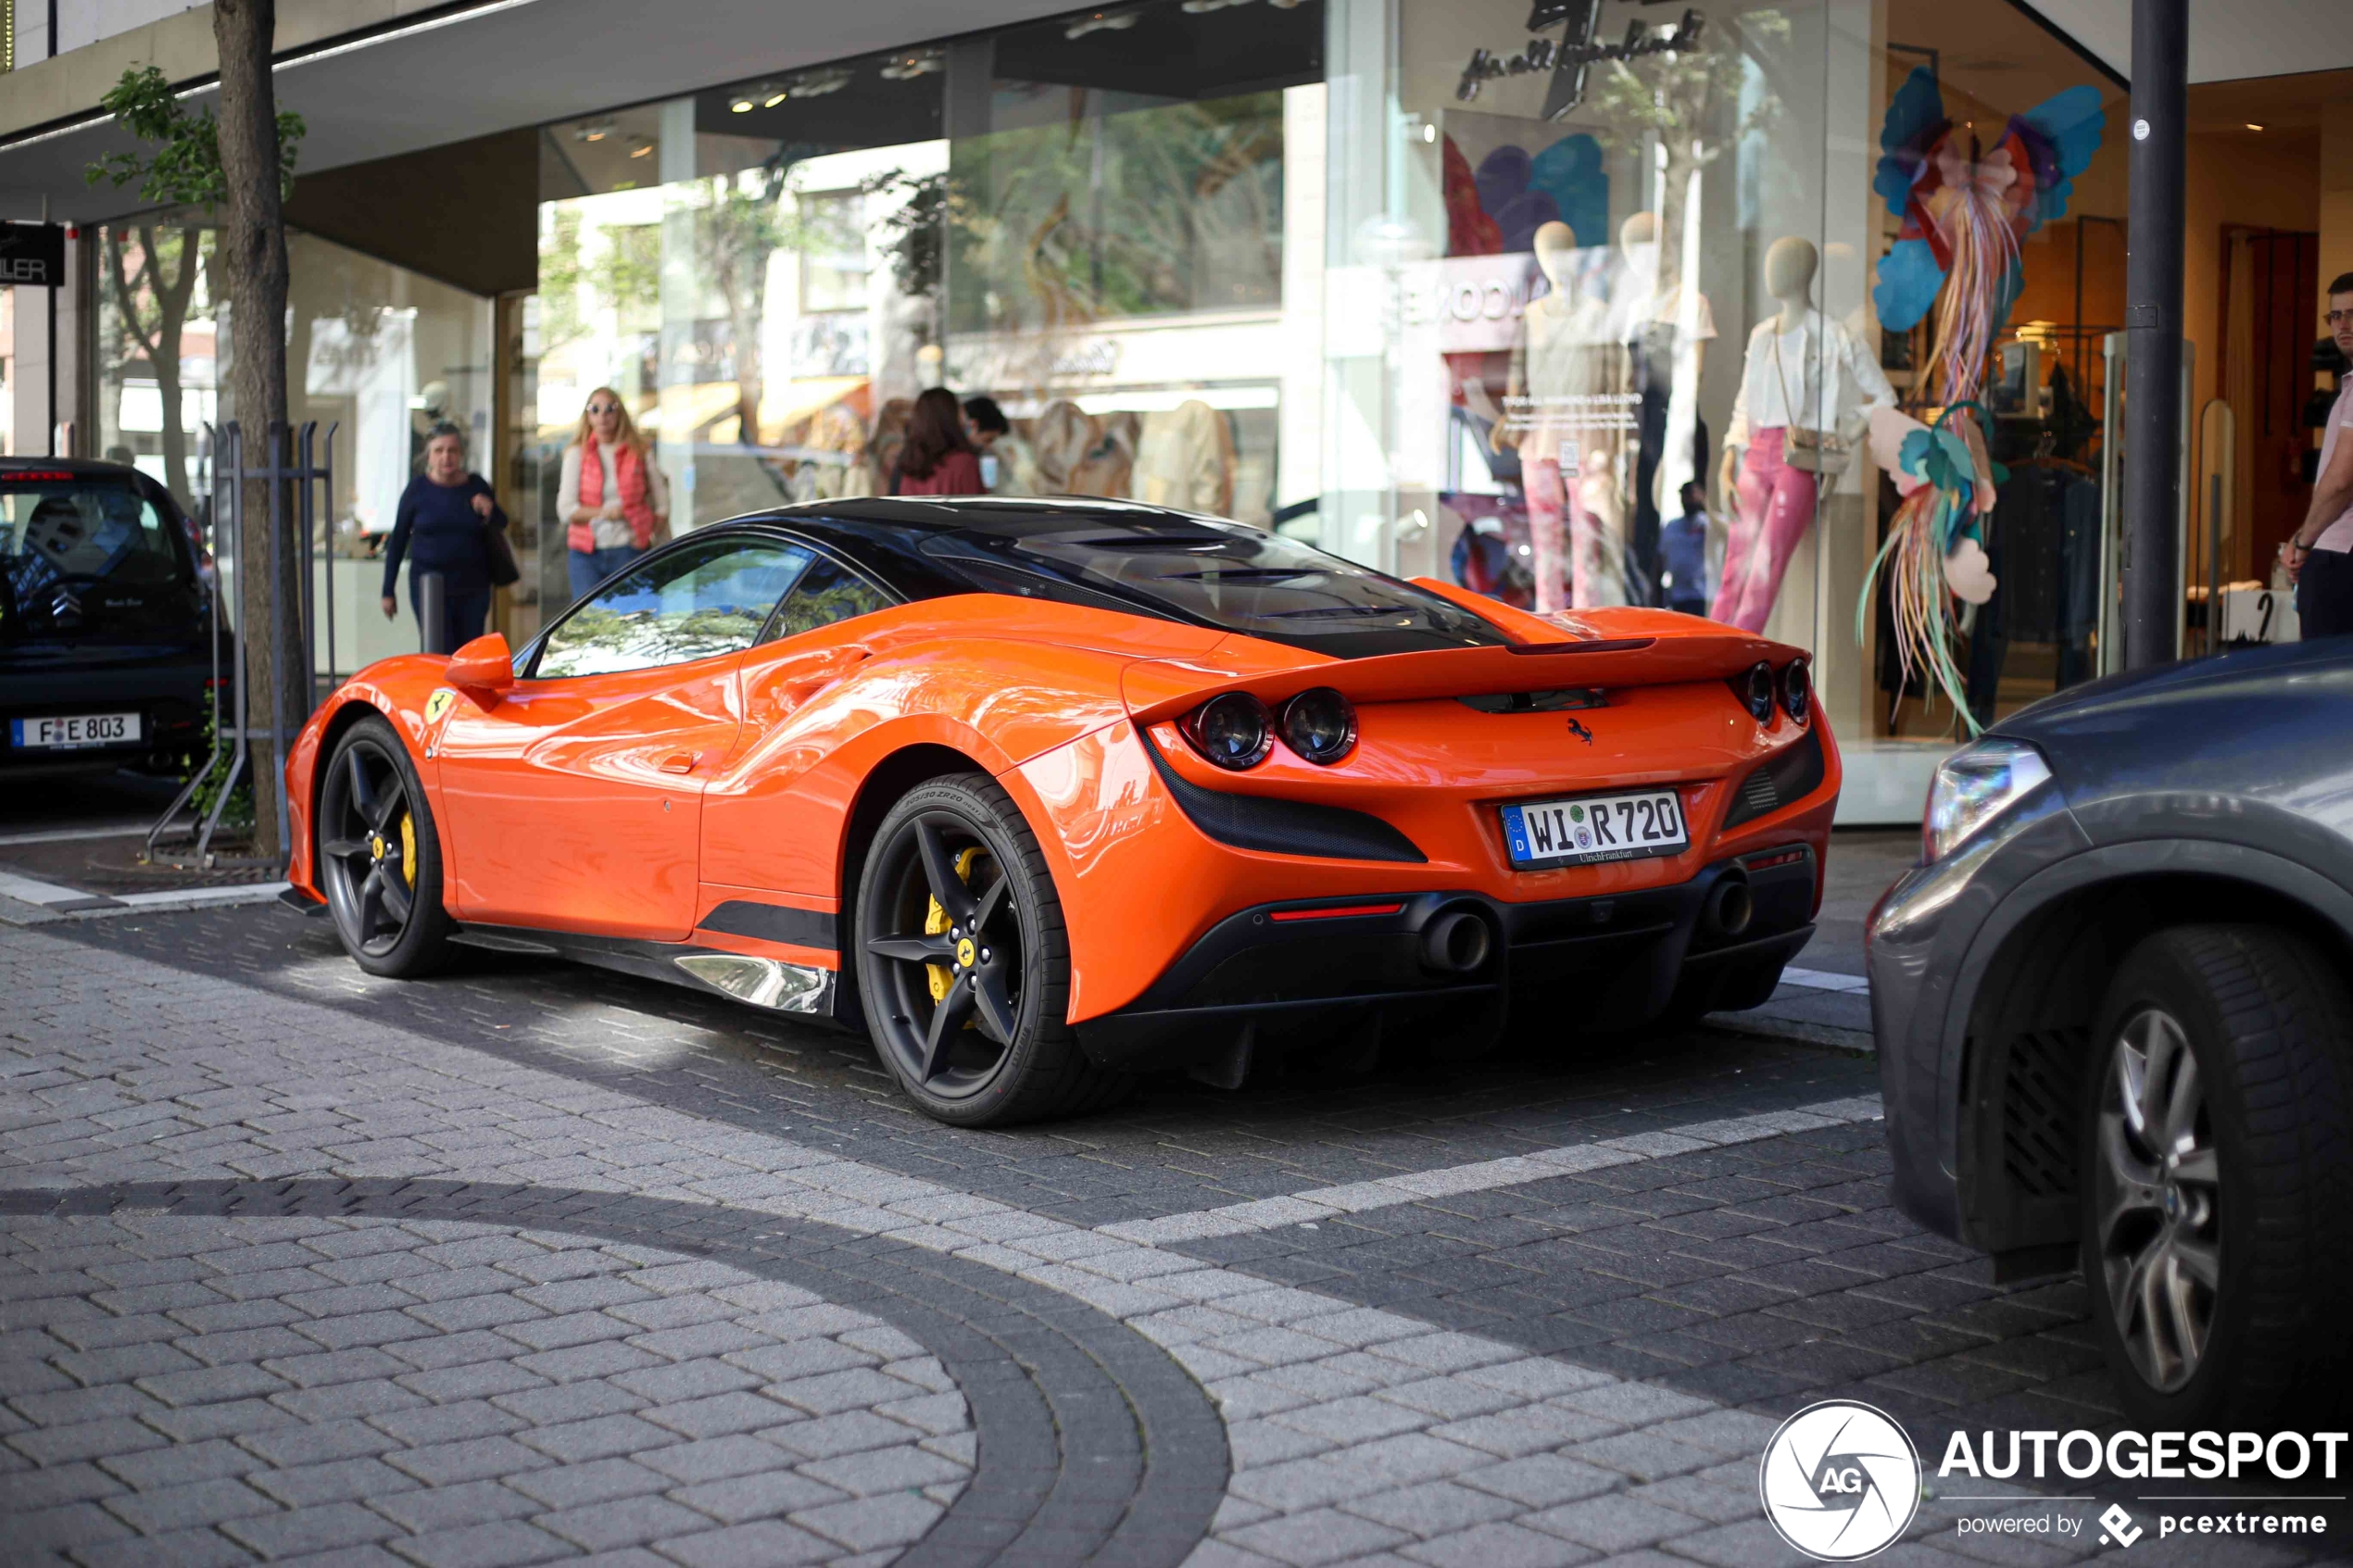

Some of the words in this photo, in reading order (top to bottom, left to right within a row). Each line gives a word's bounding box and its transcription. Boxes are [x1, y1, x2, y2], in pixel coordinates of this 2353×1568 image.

[40, 721, 53, 742] F
[68, 720, 82, 741] E
[86, 717, 125, 739] 803
[1516, 839, 1525, 851] D
[1528, 809, 1574, 852] WI
[1589, 804, 1617, 845] R
[1616, 797, 1679, 842] 720
